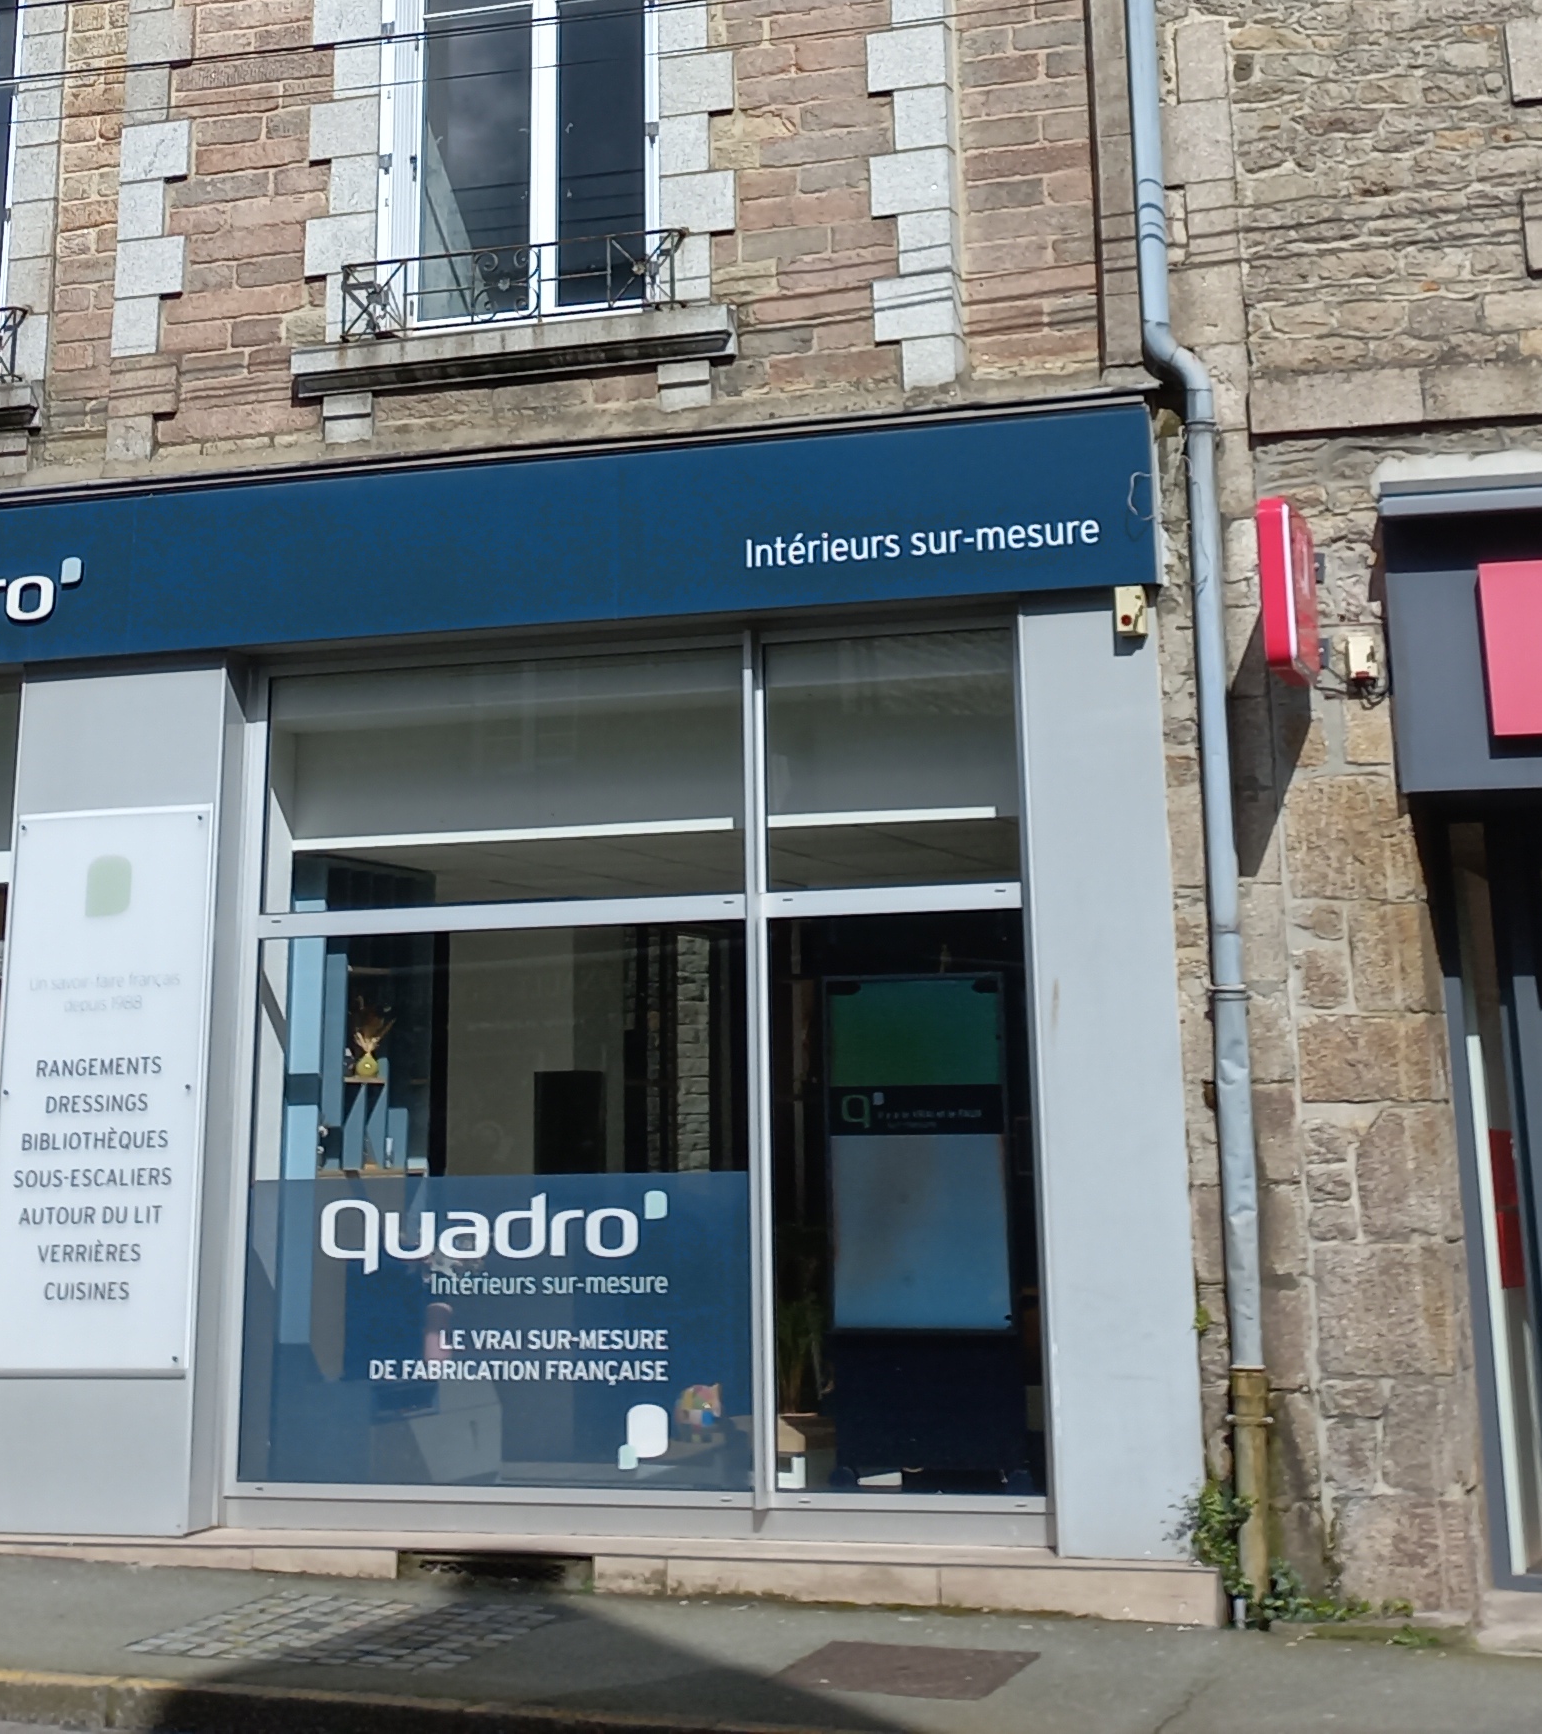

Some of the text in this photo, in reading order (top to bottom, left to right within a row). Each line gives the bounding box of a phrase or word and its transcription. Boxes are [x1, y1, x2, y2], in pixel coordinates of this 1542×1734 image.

[745, 518, 1100, 568] Intérieurs sur-mesure
[36, 1056, 162, 1078] RANGEMENTS
[46, 1093, 149, 1114] DRESSINGS
[21, 1127, 169, 1151] BIBLIOTHÈQUES
[13, 1167, 172, 1188] SOUS-ESCALIERS
[18, 1205, 163, 1225] AUTOUR DU LIT
[320, 1192, 639, 1275] Quadro
[37, 1239, 141, 1263] VERRIÈRES
[43, 1281, 130, 1301] CUISINES
[430, 1271, 668, 1295] Intérieurs sur-mesure
[439, 1329, 669, 1351] LE VRAI SUR-MESURE
[368, 1359, 669, 1386] DE FABRICATION FRANÇAISE
